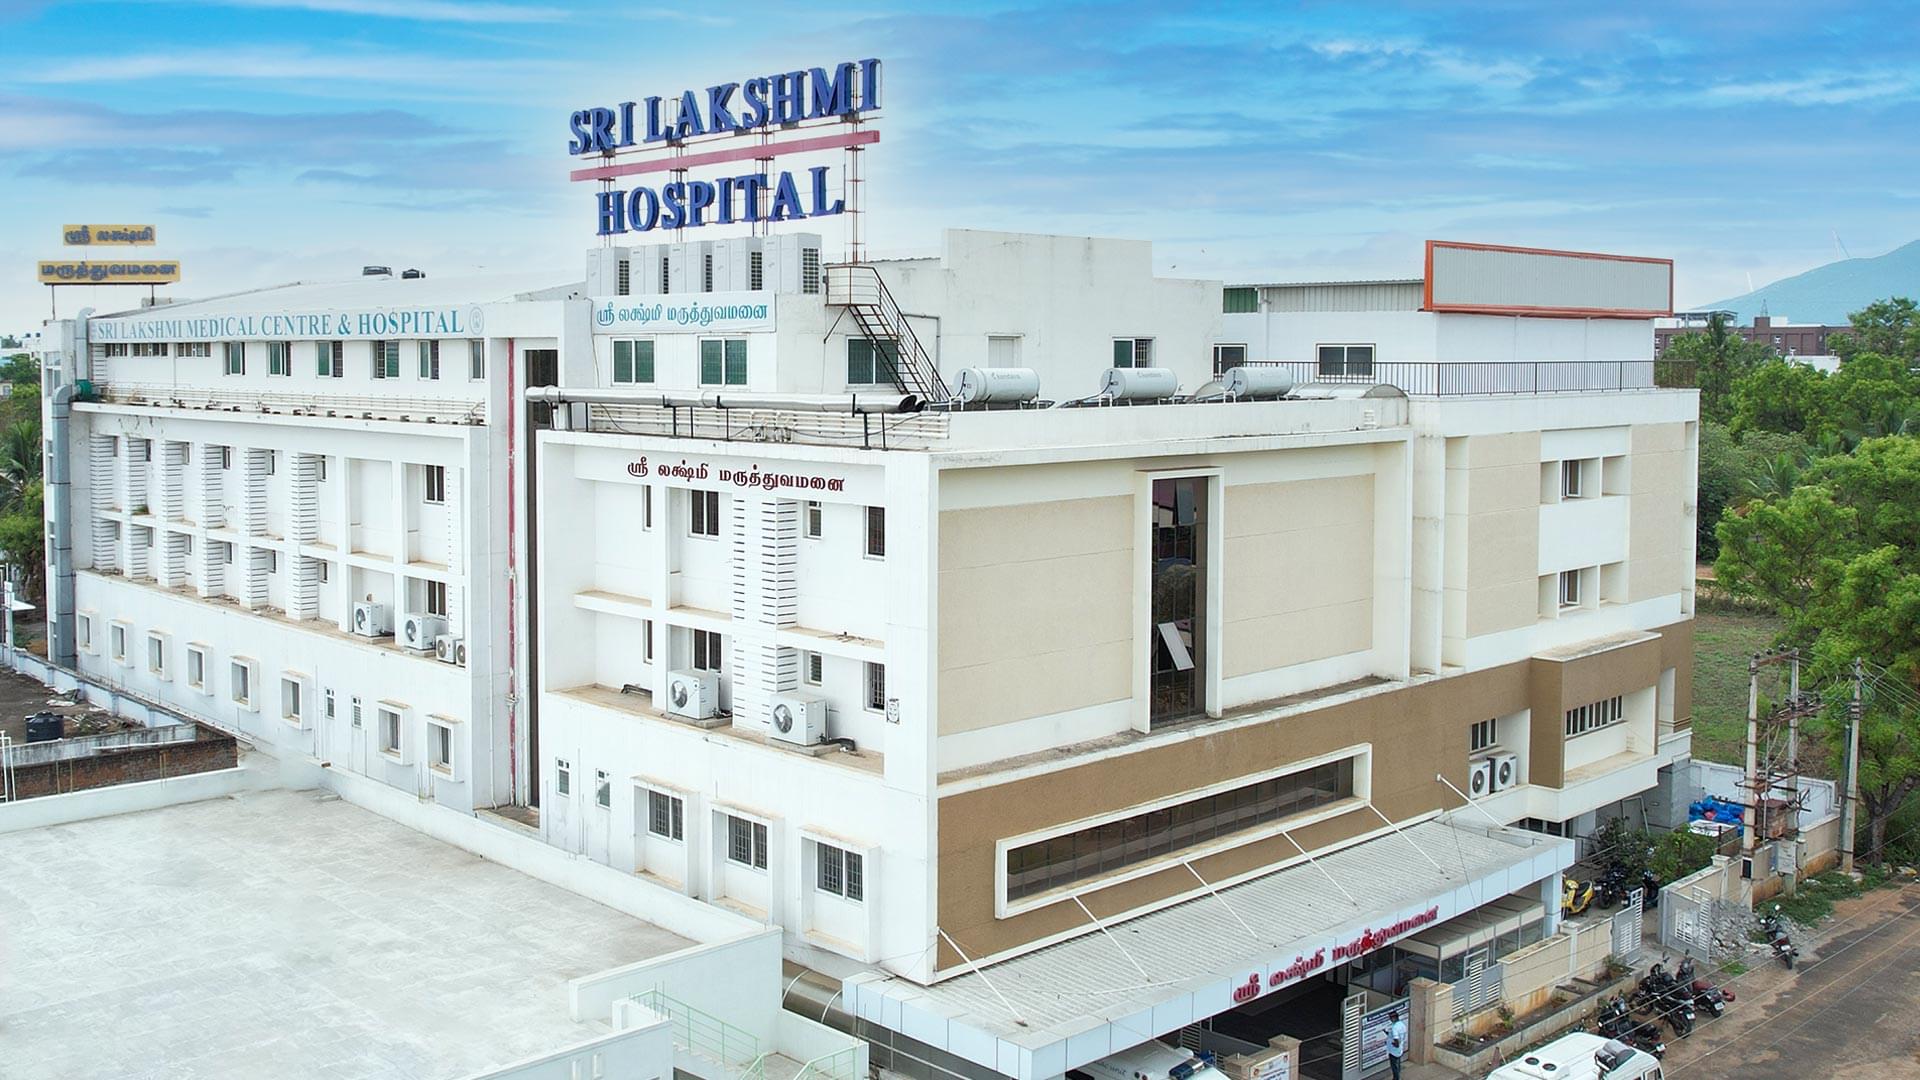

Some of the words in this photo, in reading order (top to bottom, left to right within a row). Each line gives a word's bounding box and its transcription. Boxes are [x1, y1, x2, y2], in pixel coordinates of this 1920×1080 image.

[569, 102, 636, 154] SRI
[644, 58, 882, 143] LAKSHMI
[596, 166, 845, 236] HOSPITAL
[41, 261, 176, 281] மருத்துவமனை
[98, 322, 117, 340] SRI
[121, 320, 182, 339] LAKSHMI
[187, 316, 258, 338] MEDICAL
[261, 314, 332, 336] CENTRE
[338, 314, 351, 336] &
[358, 310, 465, 335] HOSPITAL
[667, 301, 768, 326] மருத்துவமனை
[719, 464, 845, 492] மருத்துவமனை
